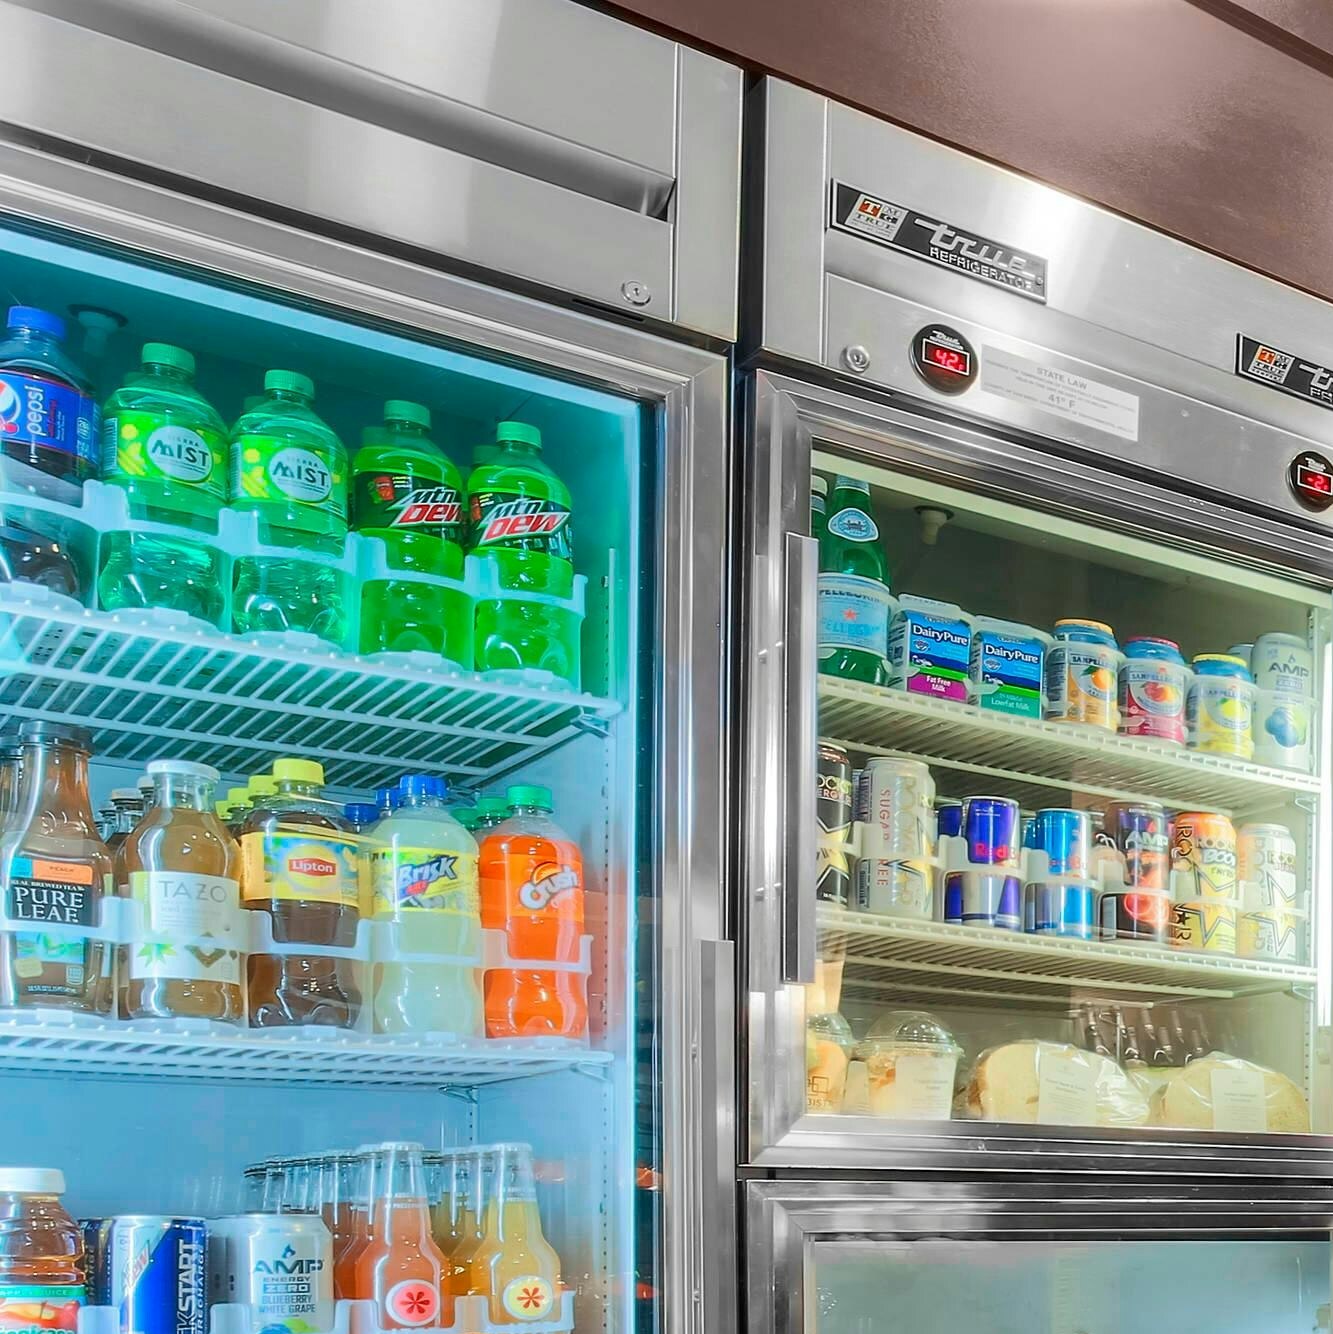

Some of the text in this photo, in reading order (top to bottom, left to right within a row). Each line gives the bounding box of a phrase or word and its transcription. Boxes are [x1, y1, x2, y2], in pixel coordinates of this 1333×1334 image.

[1036, 367, 1088, 390] STATE LAW
[24, 385, 44, 436] pepsi
[912, 624, 969, 646] DairyPure
[985, 645, 1039, 664] DairyPure
[291, 860, 333, 874] Lipton
[399, 855, 459, 890] Brisk
[15, 887, 84, 909] PURE
[159, 880, 227, 903] TAZO
[16, 903, 79, 923] LEAF
[254, 1258, 324, 1275] AMP
[265, 1285, 310, 1293] ZERO
[262, 1295, 312, 1304] BLUEBERRY
[289, 1303, 315, 1313] GRAPE
